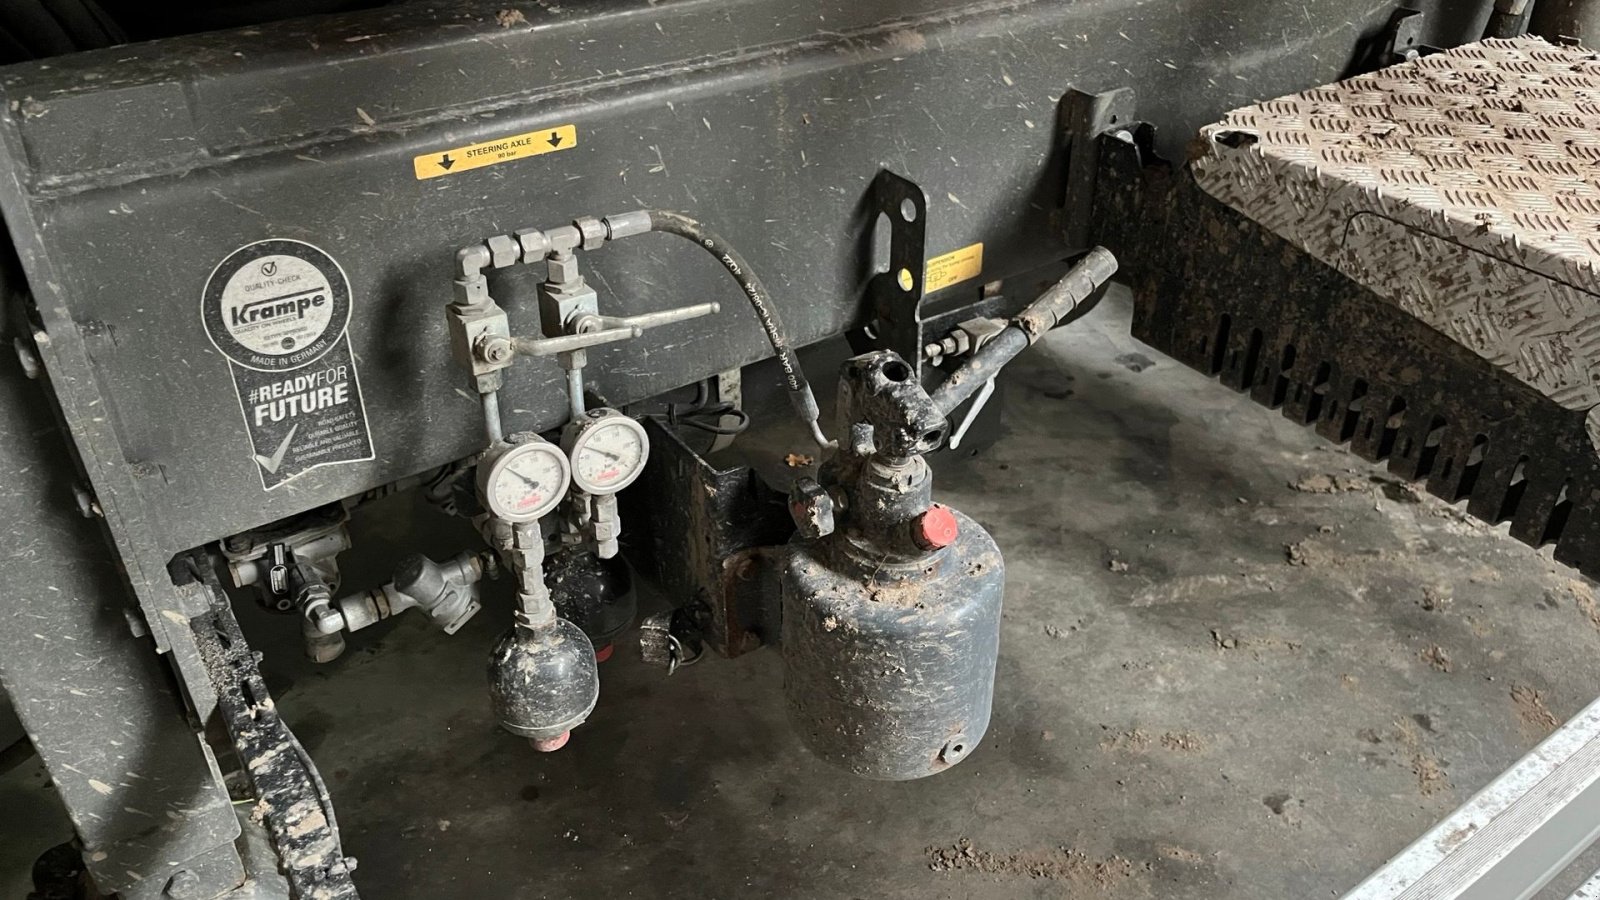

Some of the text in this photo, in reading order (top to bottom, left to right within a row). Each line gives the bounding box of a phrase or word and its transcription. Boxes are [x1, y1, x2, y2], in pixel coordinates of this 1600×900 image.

[466, 137, 532, 158] STEERING AXLE
[722, 253, 742, 275] 4Q22
[244, 274, 302, 293] QUALITY-CHECK
[230, 291, 326, 327] Krampe
[250, 355, 276, 366] MADE
[278, 357, 288, 365] IN
[290, 338, 328, 364] GERMANY
[779, 351, 793, 374] BAR
[248, 365, 348, 404] #READYFOR
[787, 374, 799, 391] 400
[255, 382, 349, 427] FUTURE
